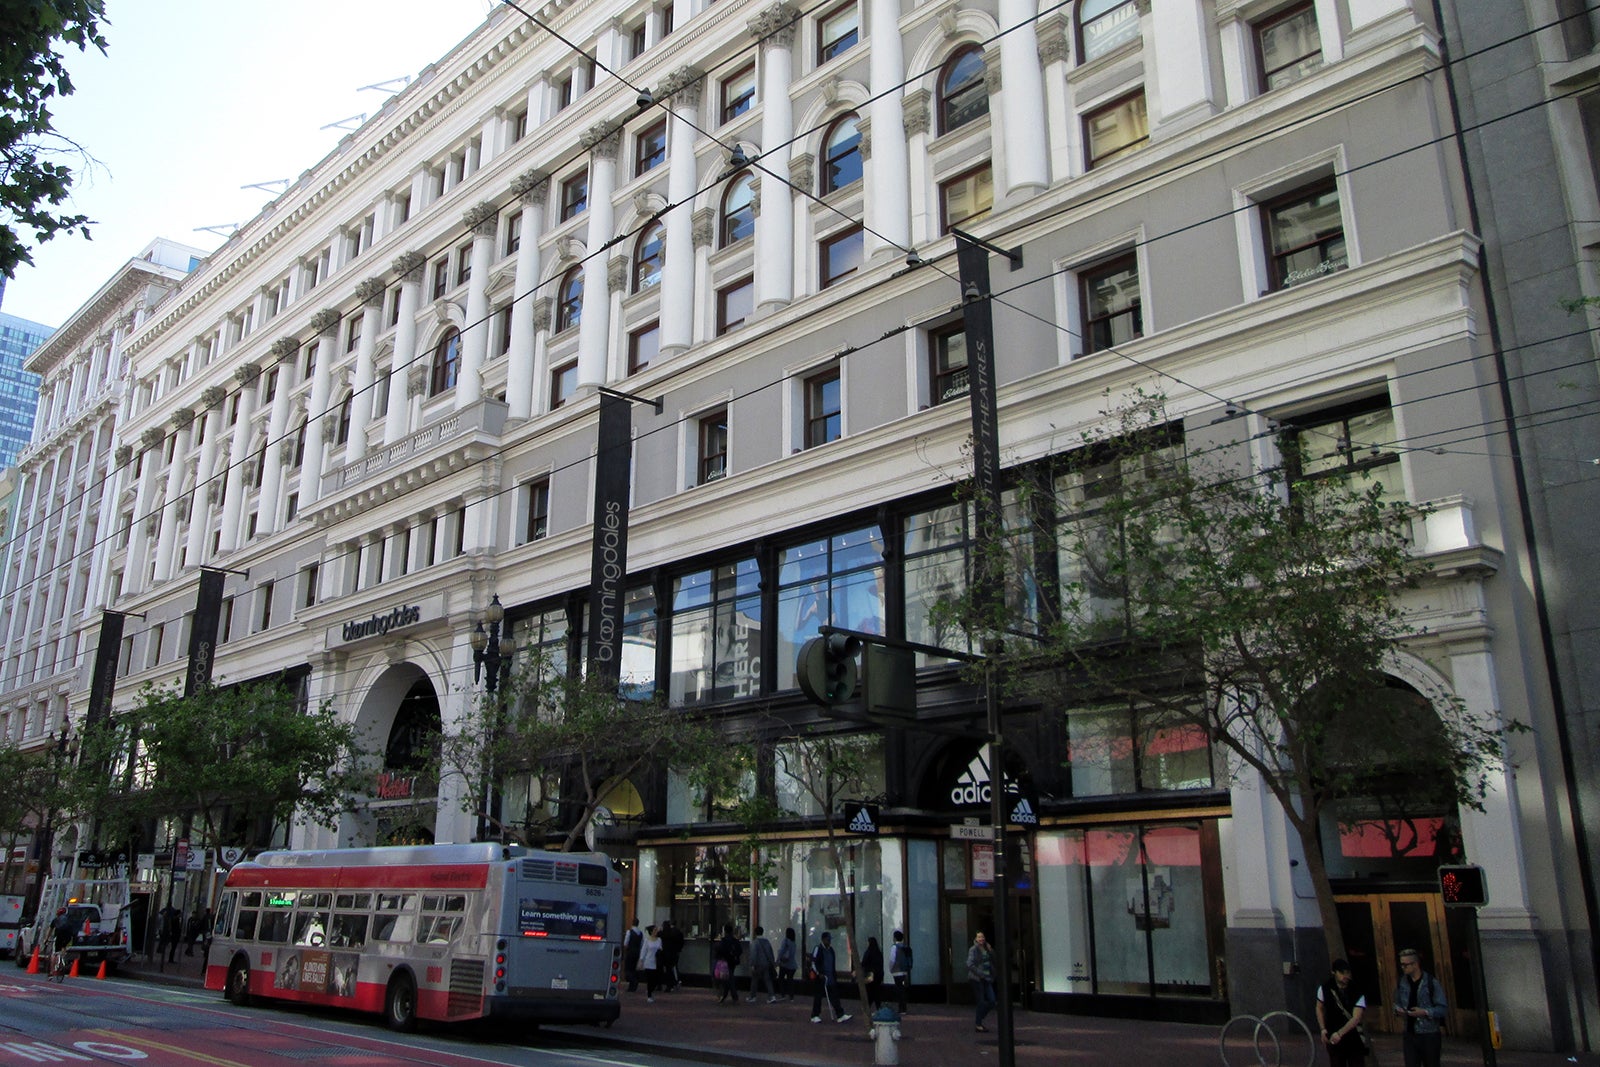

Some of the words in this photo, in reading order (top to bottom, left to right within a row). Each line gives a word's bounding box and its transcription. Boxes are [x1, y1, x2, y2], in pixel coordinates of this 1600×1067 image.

[976, 341, 990, 437] THEATRES
[734, 624, 749, 698] HERE
[749, 656, 760, 695] TO
[1010, 812, 1037, 824] adidas
[849, 822, 876, 832] adidas
[960, 828, 985, 838] POWELL
[521, 910, 541, 918] Learn
[542, 912, 577, 922] something
